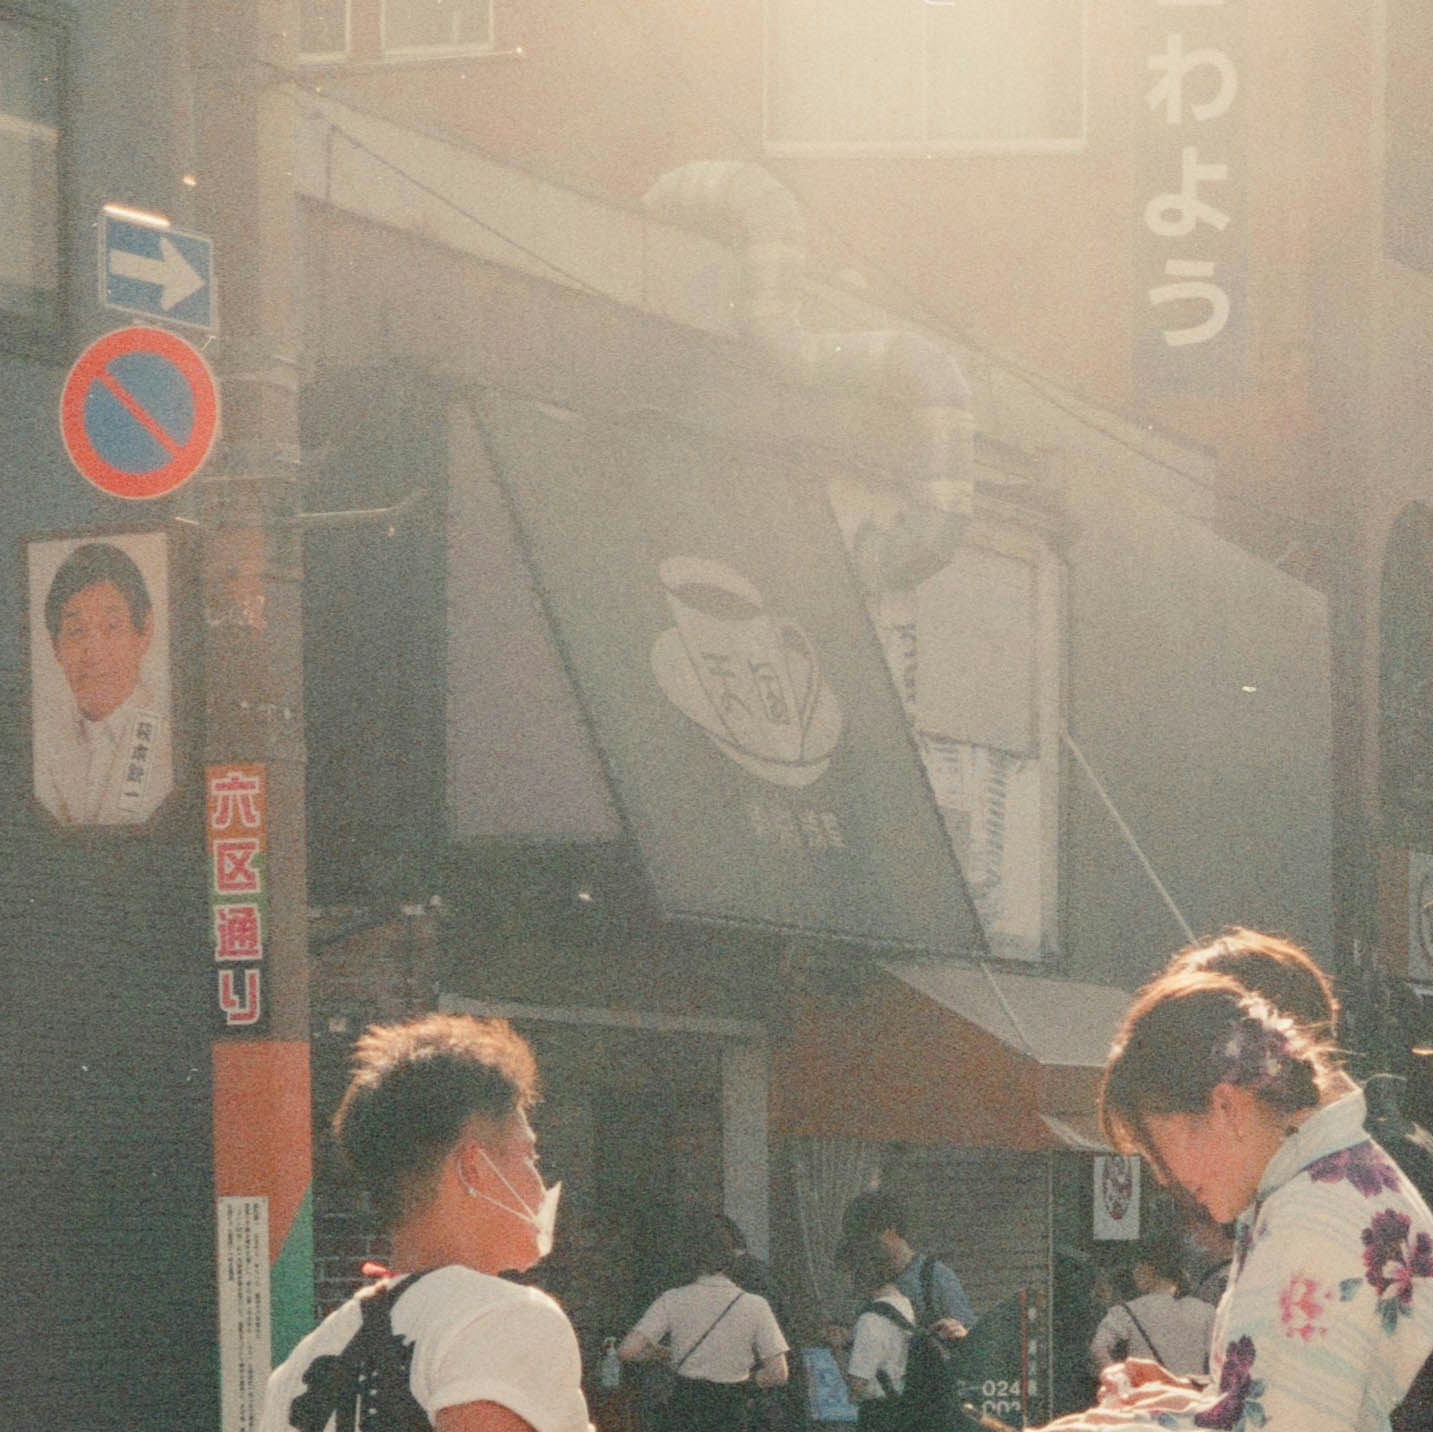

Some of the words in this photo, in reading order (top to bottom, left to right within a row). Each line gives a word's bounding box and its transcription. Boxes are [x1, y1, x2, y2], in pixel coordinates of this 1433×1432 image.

[1142, 0, 1240, 348] わよう
[208, 770, 264, 1028] 六区通り
